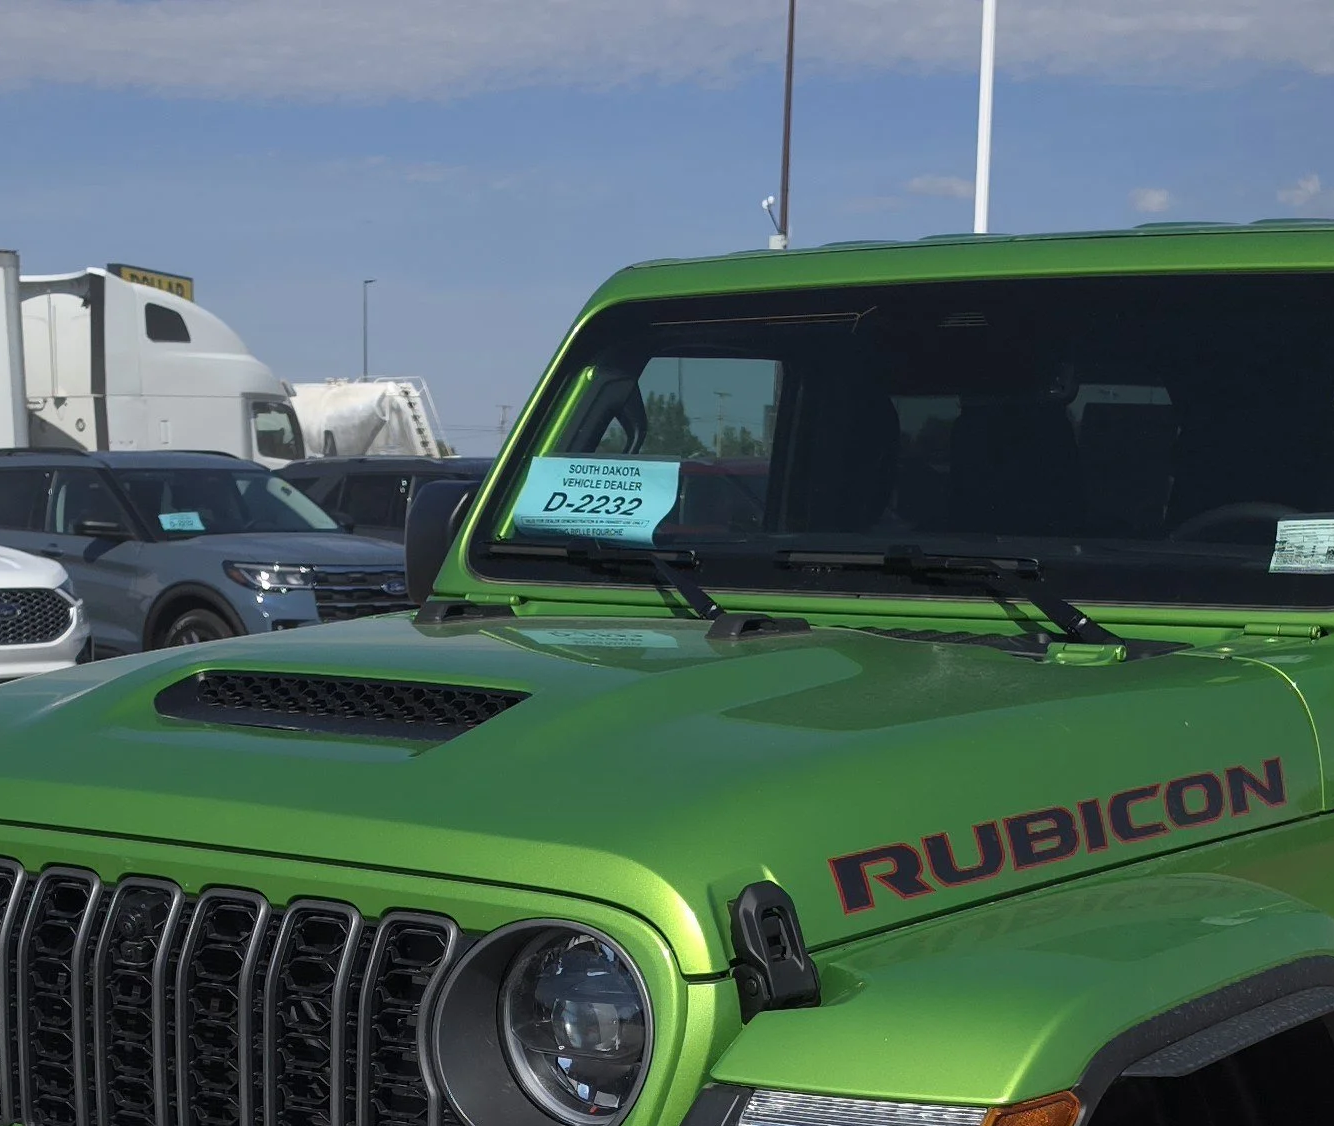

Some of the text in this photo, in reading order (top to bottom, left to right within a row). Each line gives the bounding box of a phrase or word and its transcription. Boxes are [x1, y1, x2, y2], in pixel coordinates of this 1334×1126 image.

[569, 464, 641, 478] SOUTH DAKOTA
[562, 478, 643, 492] VEHICLE DEALER
[542, 491, 643, 516] D-2232
[828, 756, 1287, 915] RUBICON
